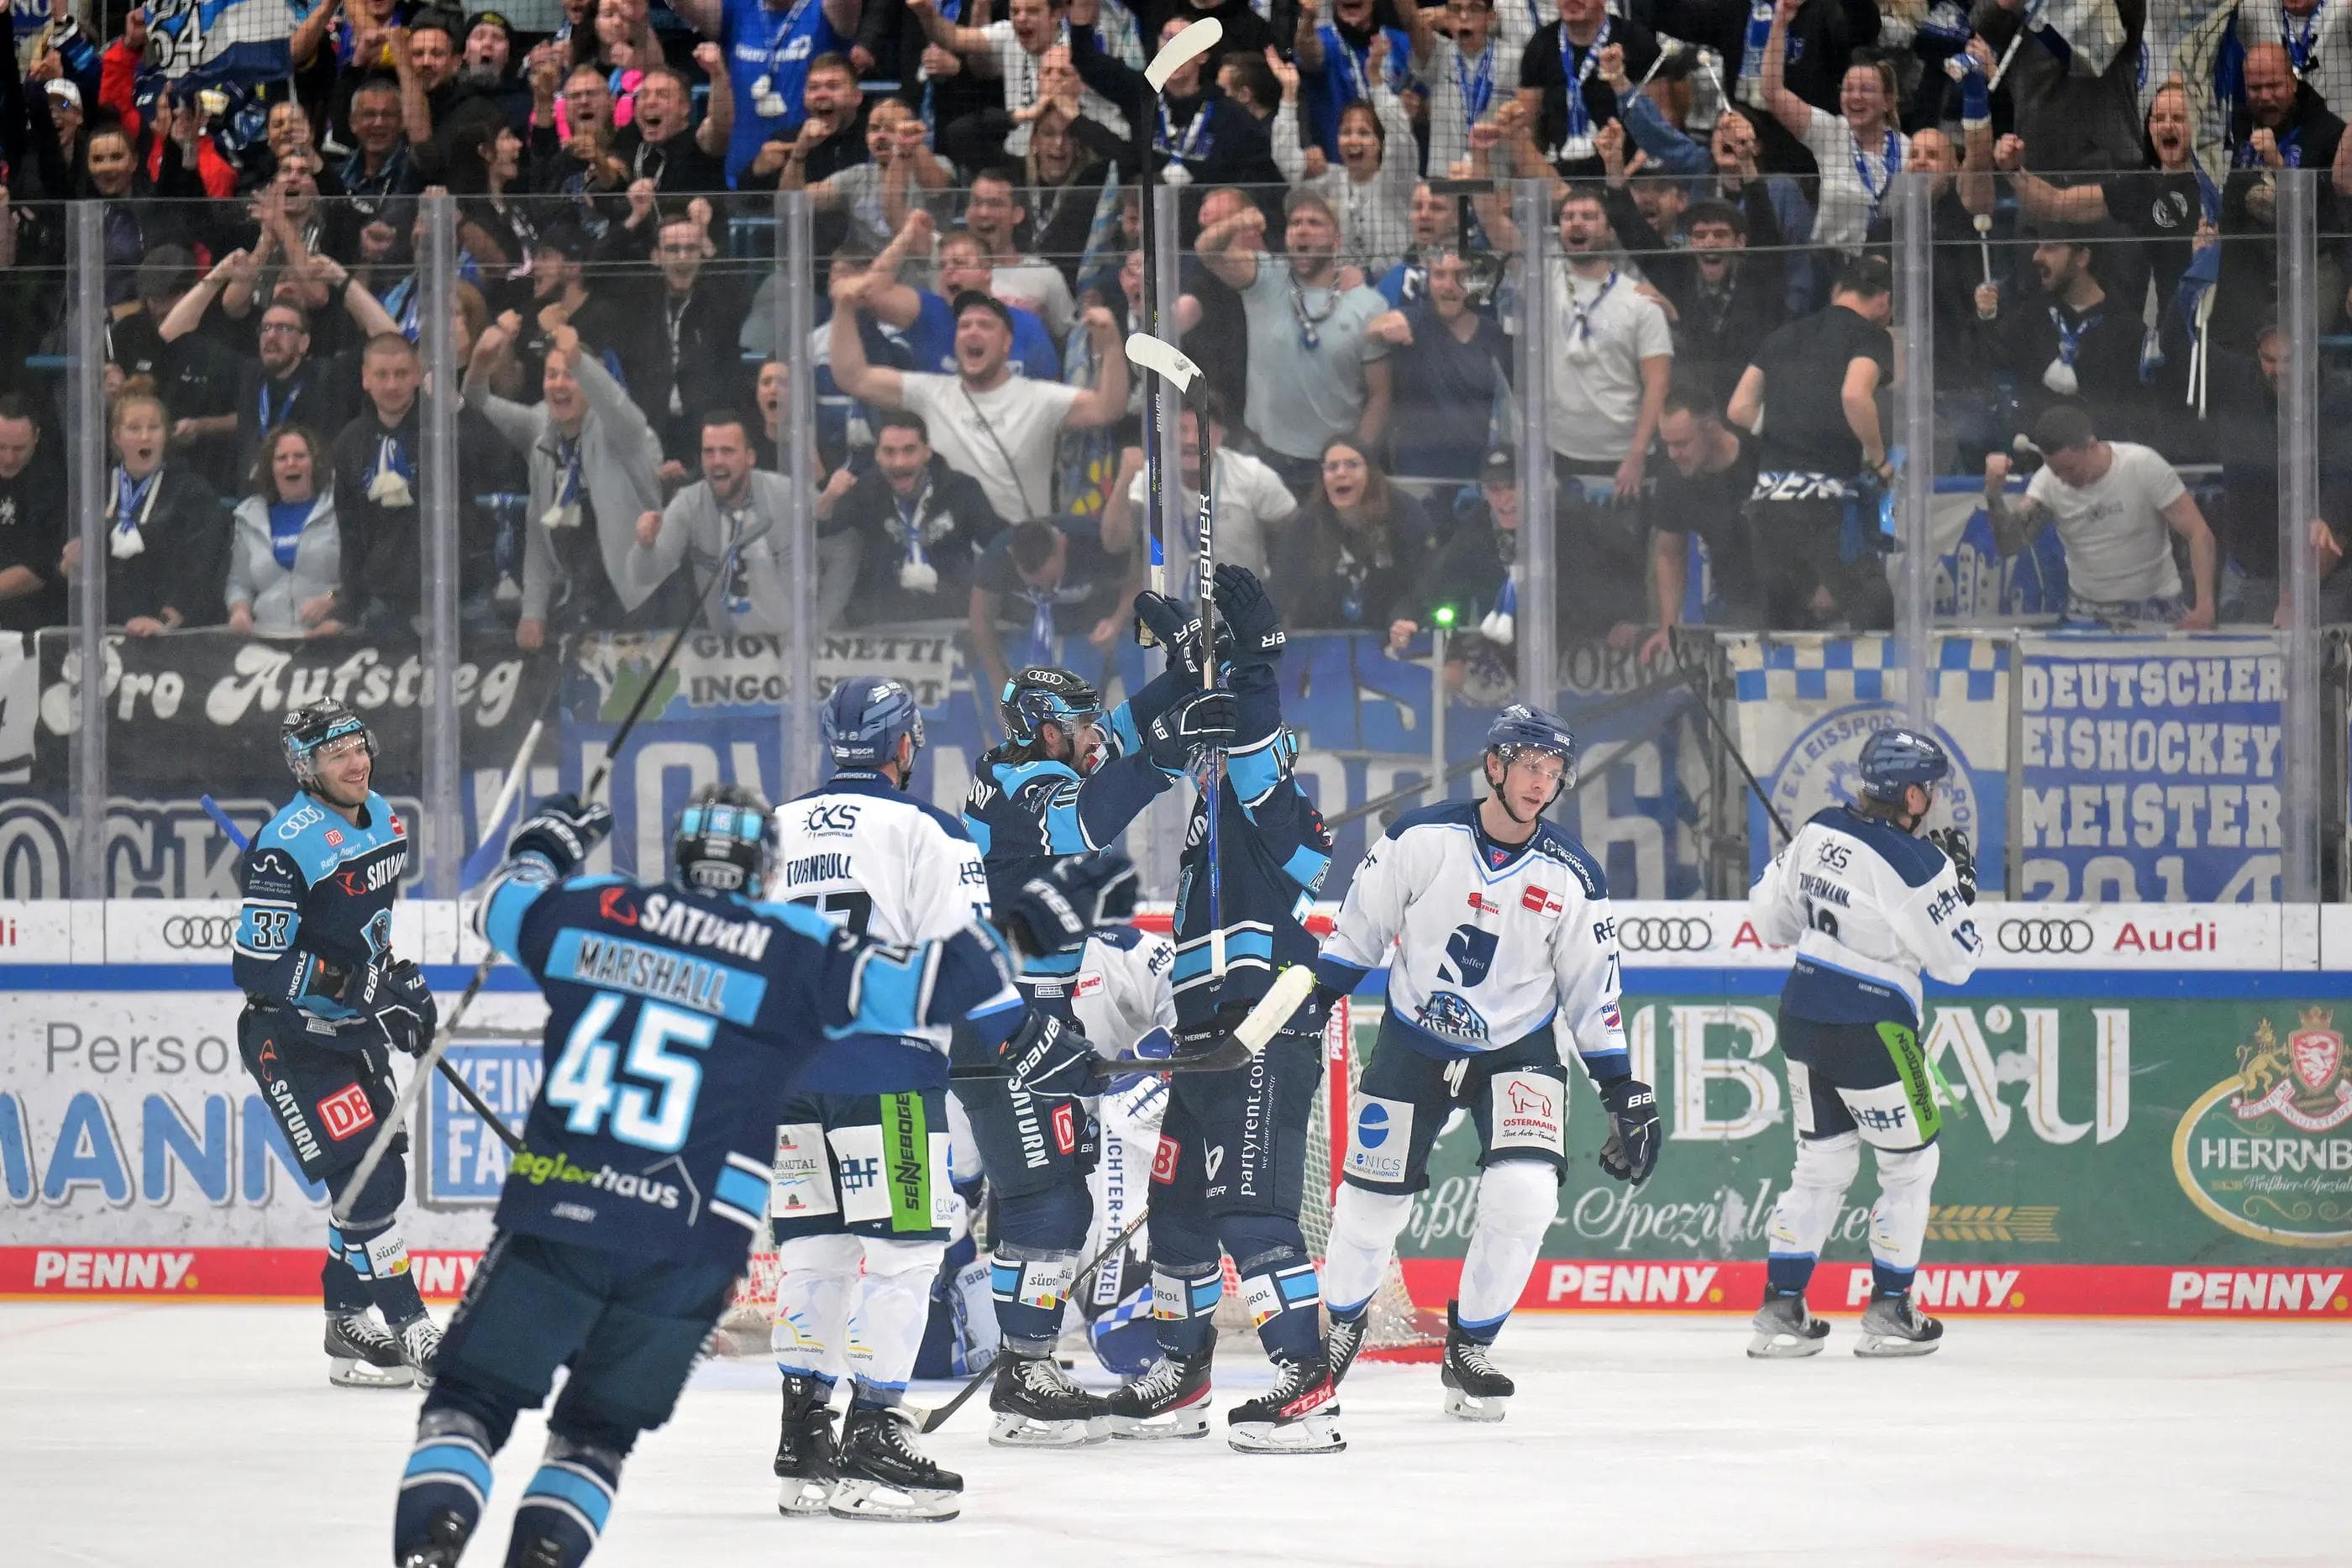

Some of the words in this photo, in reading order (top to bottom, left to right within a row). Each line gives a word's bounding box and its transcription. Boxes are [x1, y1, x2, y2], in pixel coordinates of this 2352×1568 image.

[1200, 494, 1210, 600] BAUER
[692, 634, 944, 663] GIOVNETTI
[2023, 657, 2287, 712] DEUTSCHER
[2023, 716, 2282, 778] EISHOCKEY
[808, 804, 861, 831] CKS
[2023, 783, 2282, 849] MEISTER
[786, 852, 853, 888] TURNBULL
[254, 910, 290, 949] 33
[638, 893, 773, 962] SATURN
[2113, 921, 2217, 952] Audi
[287, 949, 307, 998] INGOLS
[575, 934, 729, 1016] MARSHALL
[546, 989, 718, 1154] 45
[1016, 1015, 1062, 1078] BAUER
[326, 1089, 371, 1134] DB
[448, 1059, 543, 1113] KEIN
[270, 1079, 322, 1163] SATURN
[1008, 1078, 1050, 1169] SATURN
[1504, 1119, 1558, 1133] OSTERMAIER
[448, 1118, 526, 1185] FA
[2201, 1137, 2352, 1173] HERRNB
[1152, 1392, 1178, 1410] CCM
[1284, 1385, 1332, 1419] CCM
